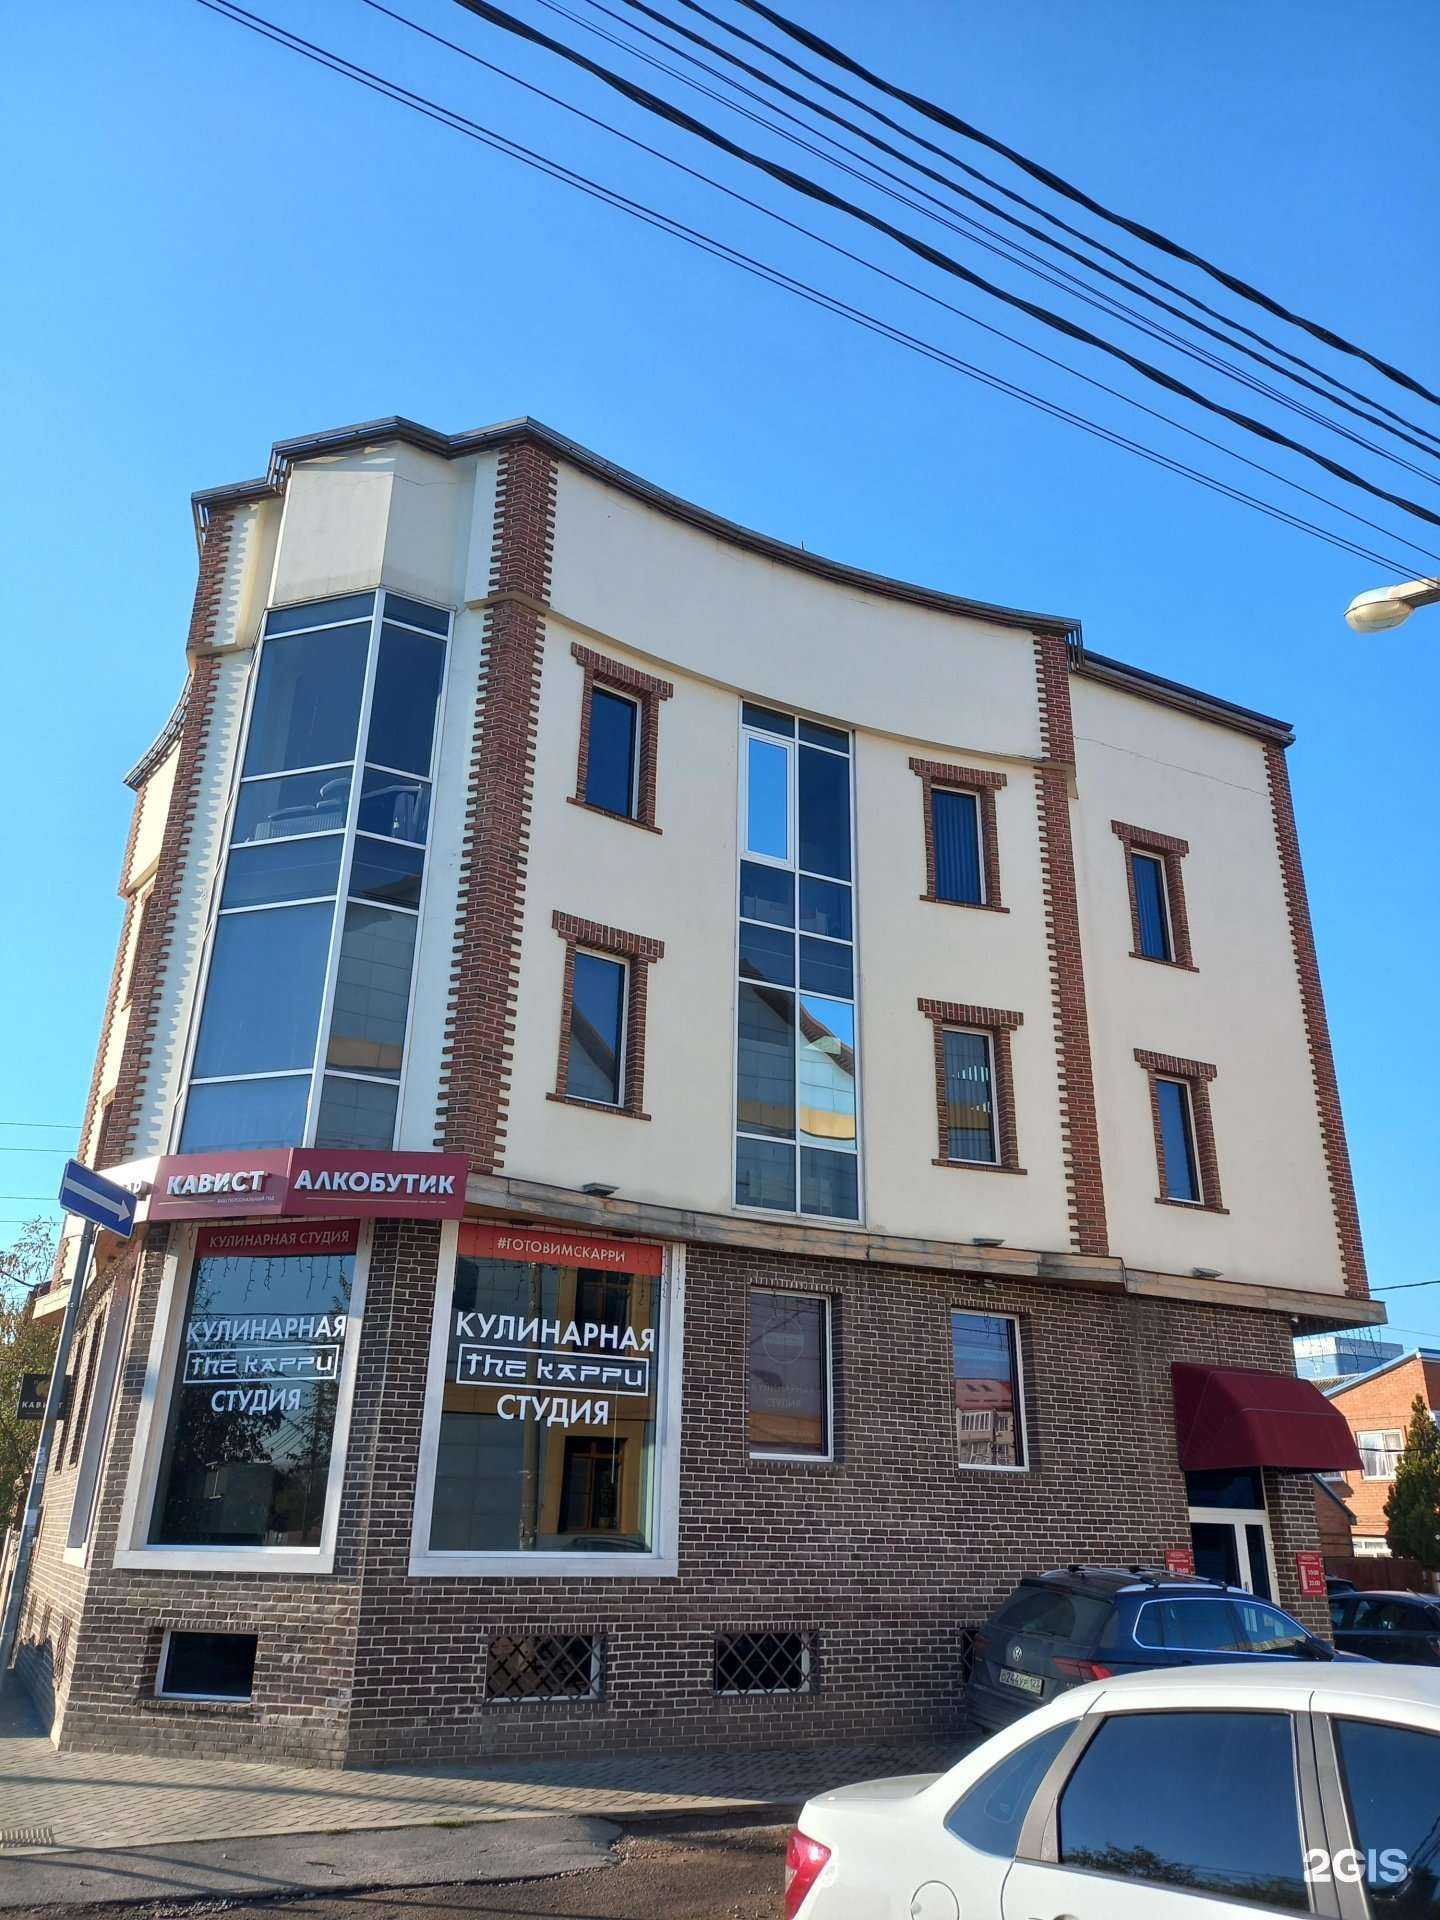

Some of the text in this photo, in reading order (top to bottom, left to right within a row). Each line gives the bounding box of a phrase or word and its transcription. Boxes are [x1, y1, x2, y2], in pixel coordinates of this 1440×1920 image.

[166, 1170, 266, 1196] КАВИСТ
[294, 1169, 456, 1195] АЛКОБУТИК
[209, 1230, 350, 1248] КУЛИНАРНАЯ СТУДИЯ
[497, 1238, 626, 1262] #ГОТОВИМСКАРРИ
[186, 1315, 348, 1344] КУЛИНАРНАЯ
[456, 1311, 655, 1353] КУЛИНАРНАЯ
[211, 1388, 302, 1416] СТУДИЯ
[496, 1394, 610, 1428] СТУДИЯ
